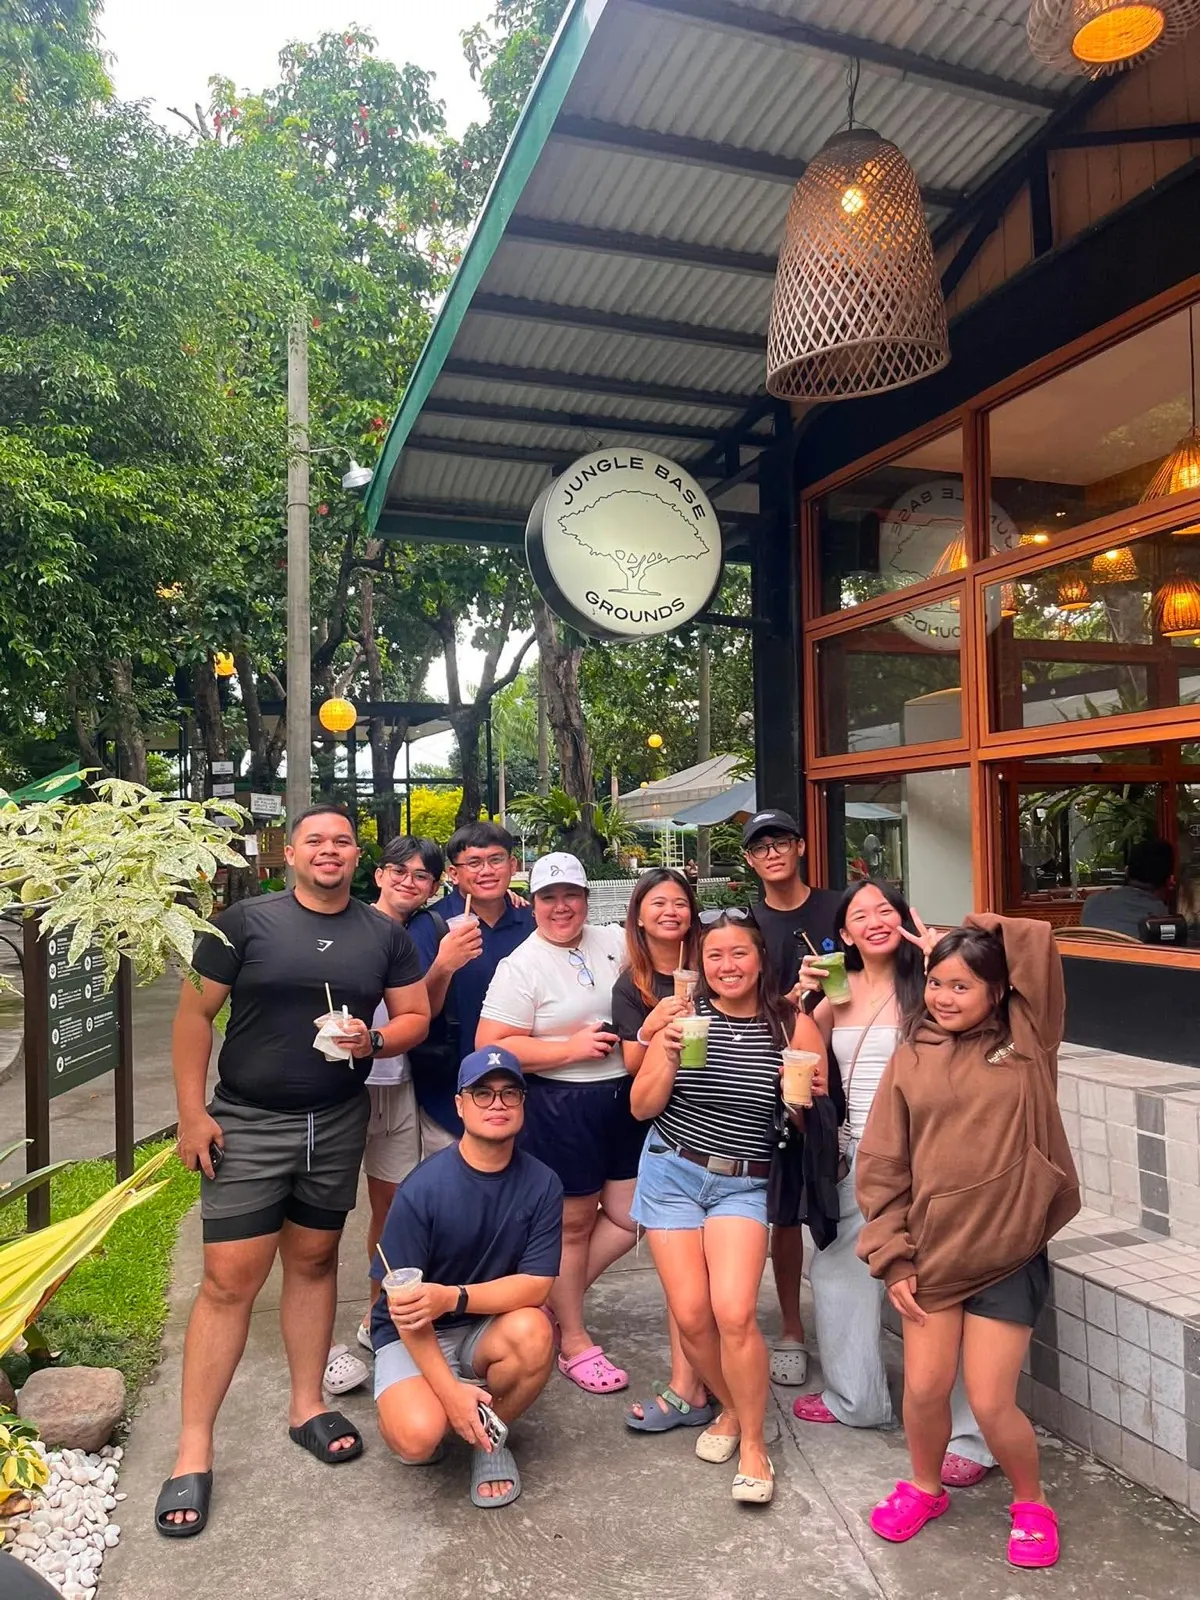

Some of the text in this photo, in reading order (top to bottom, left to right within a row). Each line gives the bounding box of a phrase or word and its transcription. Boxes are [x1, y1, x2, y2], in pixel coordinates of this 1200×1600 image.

[564, 457, 706, 520] JUNGLE BASE
[585, 590, 685, 623] GROUNDS
